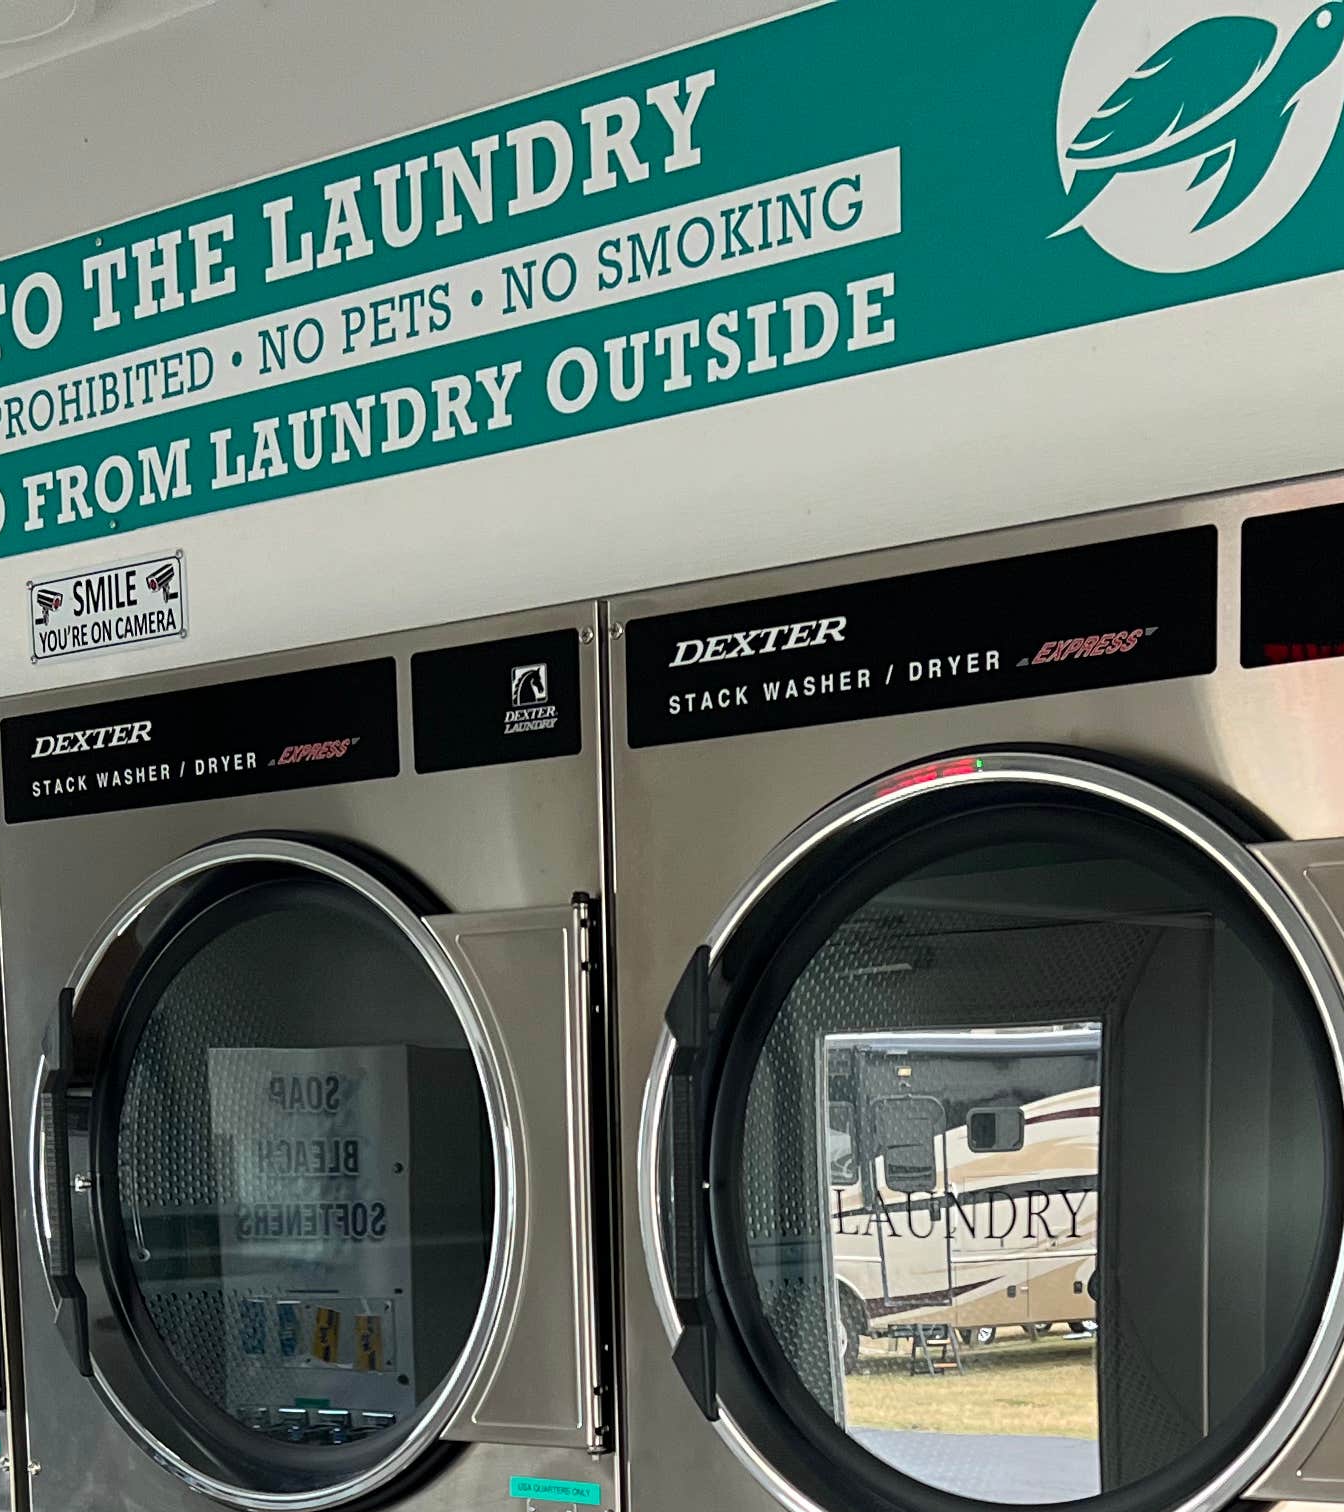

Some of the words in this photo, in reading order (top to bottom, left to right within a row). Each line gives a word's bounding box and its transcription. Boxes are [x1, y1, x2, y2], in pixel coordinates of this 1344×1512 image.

[83, 215, 235, 331] THE
[263, 70, 715, 283] LAUNDRY
[258, 319, 324, 374] NO
[342, 282, 451, 354] PETS
[502, 254, 576, 314] NO
[598, 175, 864, 290] SMOKING
[22, 438, 191, 532] FROM
[211, 362, 523, 490] LAUNDRY
[546, 273, 896, 414] OUTSIDE
[73, 569, 137, 617] SMILE
[39, 620, 88, 655] YOU'RE
[91, 619, 112, 643] ON
[115, 609, 176, 640] CAMERA
[669, 615, 846, 667] DEXTER
[669, 684, 749, 715] STACK
[762, 668, 872, 703] WASHER
[909, 649, 1001, 682] DRYER
[1033, 627, 1146, 665] EXPRESS
[32, 720, 152, 758] DEXTER
[505, 717, 557, 734] LAUNDRY
[506, 706, 556, 722] DEXTER
[32, 775, 88, 797] STACK
[97, 763, 171, 789] WASHER
[196, 751, 257, 776] DRYER
[278, 739, 351, 764] EXPRESS
[834, 1189, 1093, 1239] LAUNDRY
